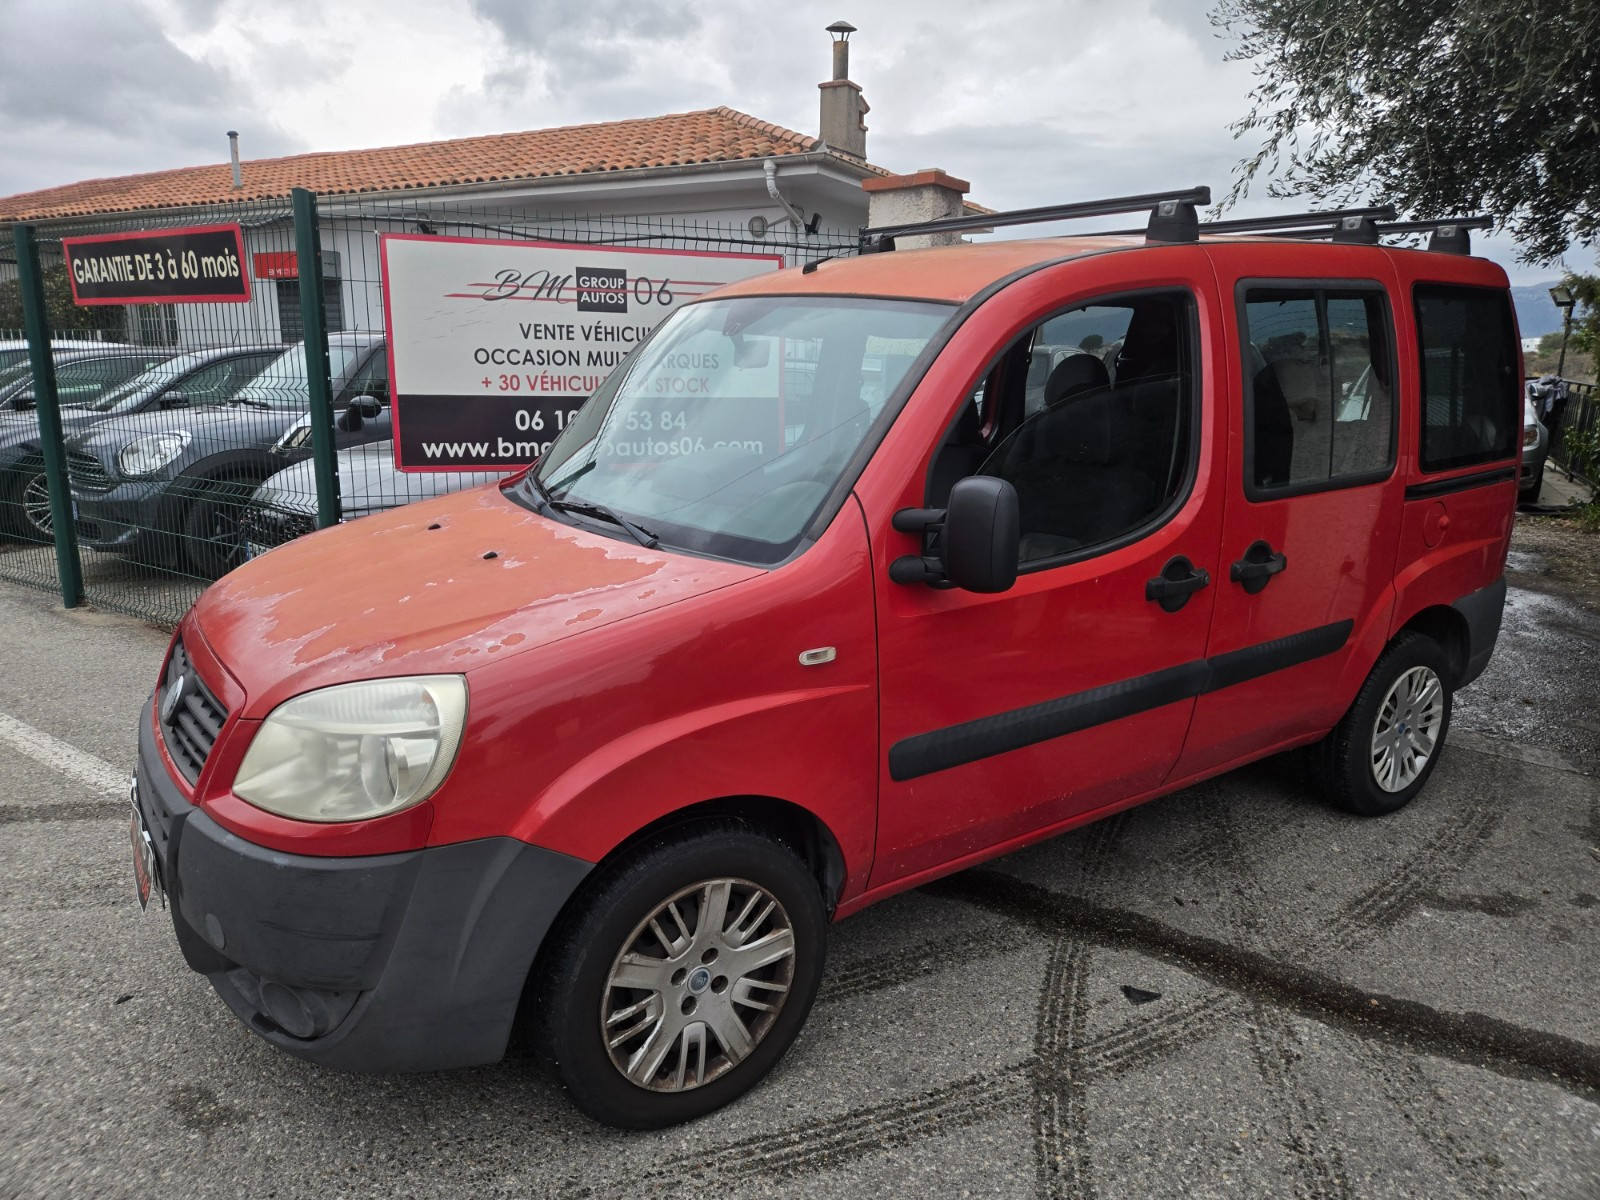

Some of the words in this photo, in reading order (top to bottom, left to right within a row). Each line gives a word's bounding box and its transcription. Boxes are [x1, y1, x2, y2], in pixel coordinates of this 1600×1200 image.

[73, 255, 134, 283] GARANTIE
[135, 253, 154, 281] DE
[155, 252, 165, 280] 3
[167, 249, 178, 280] à
[182, 250, 198, 279] 60
[201, 247, 239, 278] mois
[579, 276, 625, 289] GROUP
[634, 276, 673, 306] 06
[580, 291, 625, 304] AUTOS
[519, 323, 574, 341] VENTE
[474, 348, 580, 367] OCCASION
[482, 377, 492, 388] +
[499, 374, 520, 391] 30
[655, 377, 710, 393] STOCK
[515, 409, 544, 431] 06
[626, 410, 652, 431] 53
[660, 410, 687, 431] 84
